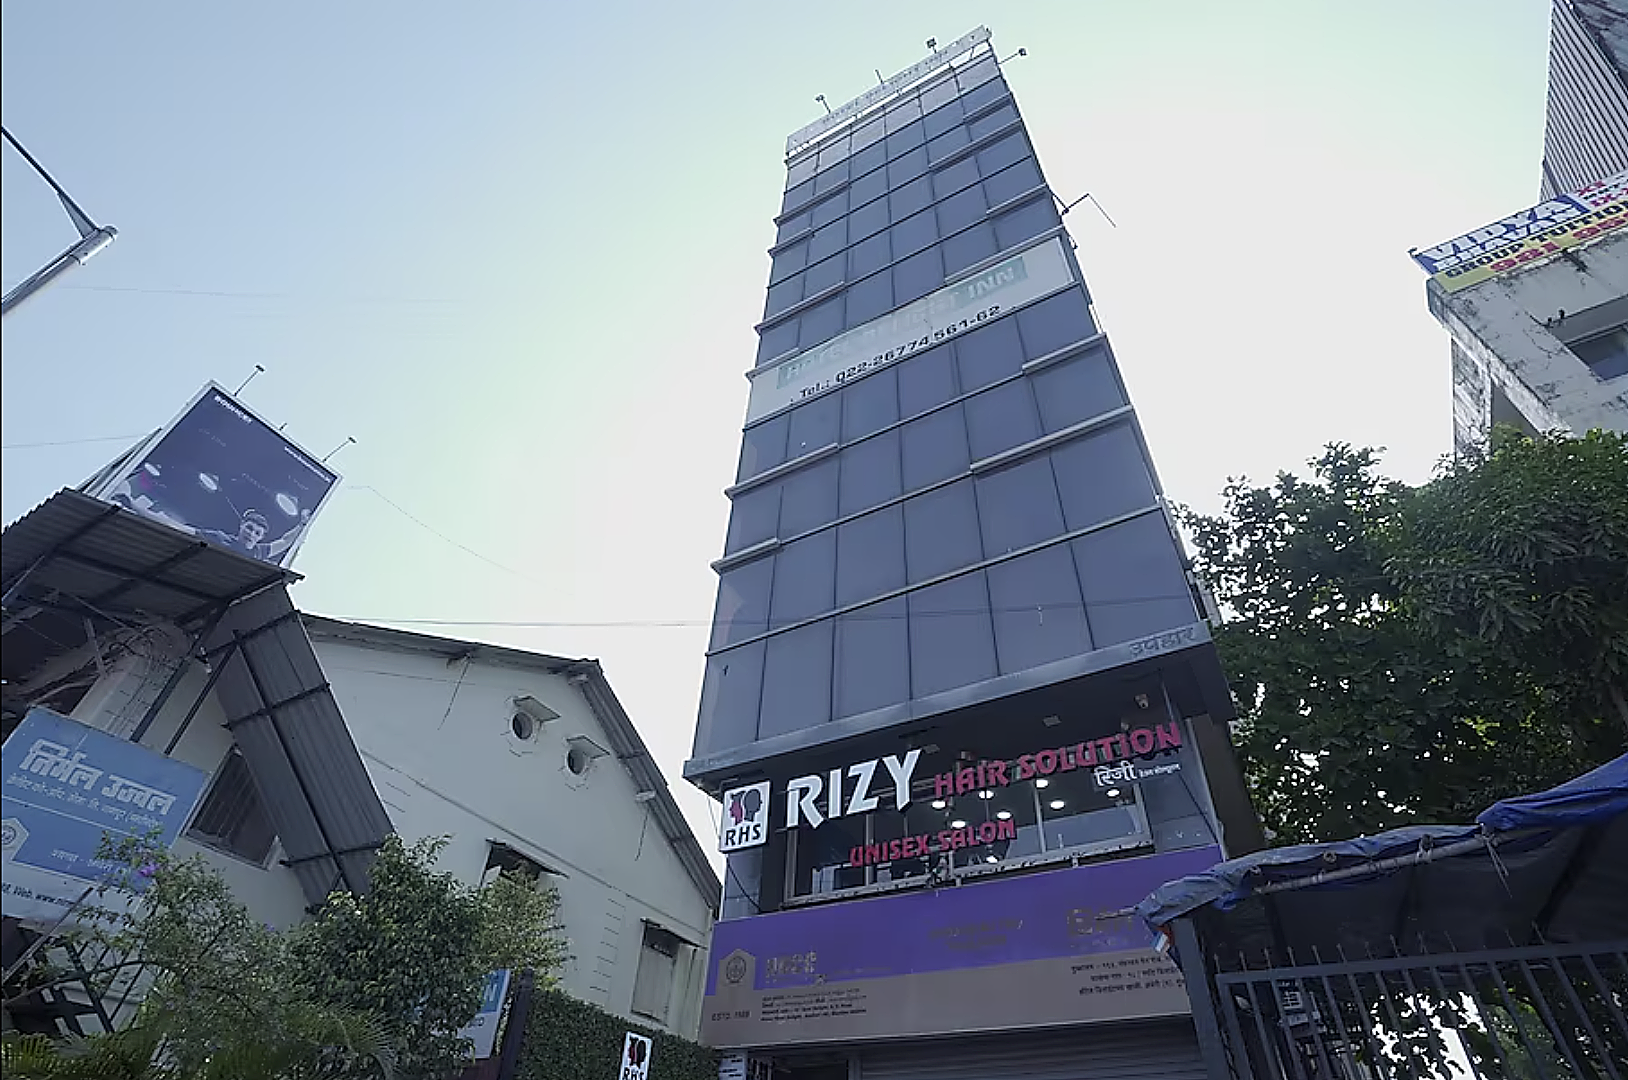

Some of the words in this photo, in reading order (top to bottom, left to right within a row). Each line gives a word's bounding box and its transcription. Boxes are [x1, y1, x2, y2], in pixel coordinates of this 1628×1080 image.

[966, 265, 1015, 299] INN
[19, 739, 104, 790] निर्मल
[933, 759, 1010, 798] HAIR
[1018, 721, 1183, 780] SOLUTION
[725, 823, 761, 846] RHS
[786, 749, 922, 829] RIZY
[849, 835, 932, 867] UNISEX
[938, 817, 1018, 852] SALON
